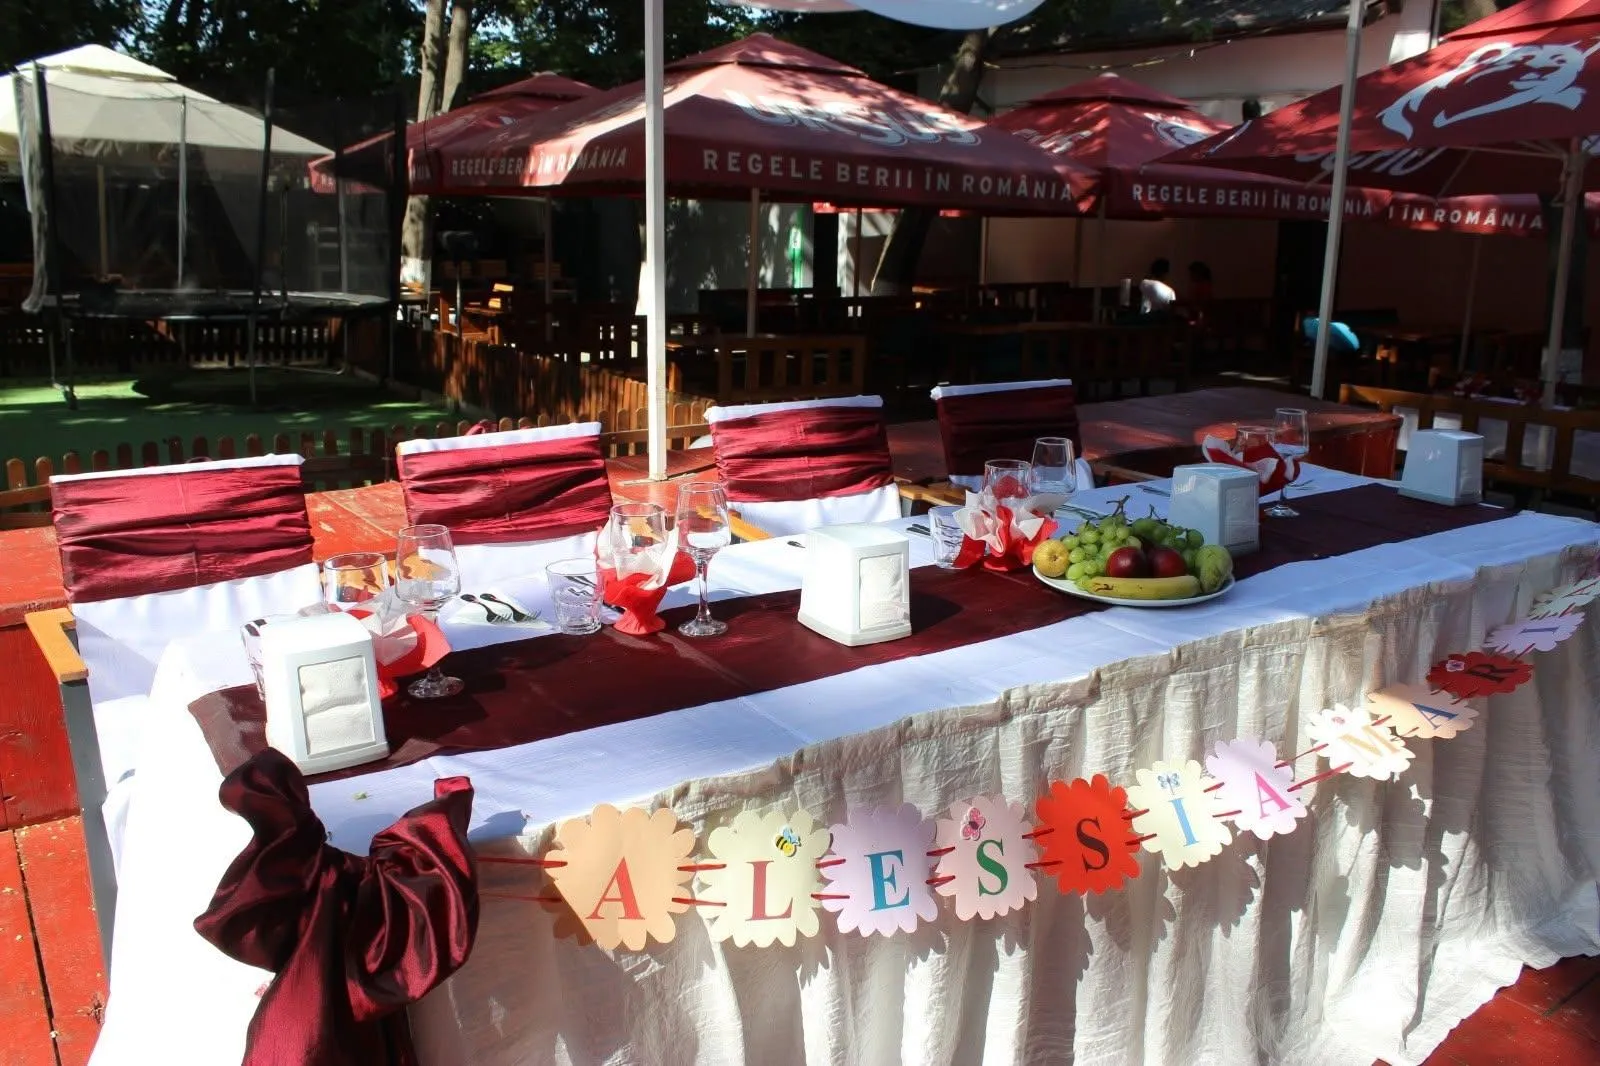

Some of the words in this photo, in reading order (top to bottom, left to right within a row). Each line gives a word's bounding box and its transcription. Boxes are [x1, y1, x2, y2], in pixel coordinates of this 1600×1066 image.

[452, 158, 494, 177] REGELE
[556, 146, 627, 172] ROMÂNIA
[703, 148, 823, 181] REGELE
[836, 162, 913, 190] BERII
[924, 164, 950, 192] ÎN
[961, 173, 1074, 201] ROMÂNIA
[1132, 183, 1208, 204] REGELE
[1215, 188, 1267, 207] BERII
[1274, 186, 1291, 211] ÎN
[1296, 194, 1373, 216] ROMNIA
[1402, 203, 1427, 222] ÎN
[1434, 207, 1543, 230] ROMÂNIA
